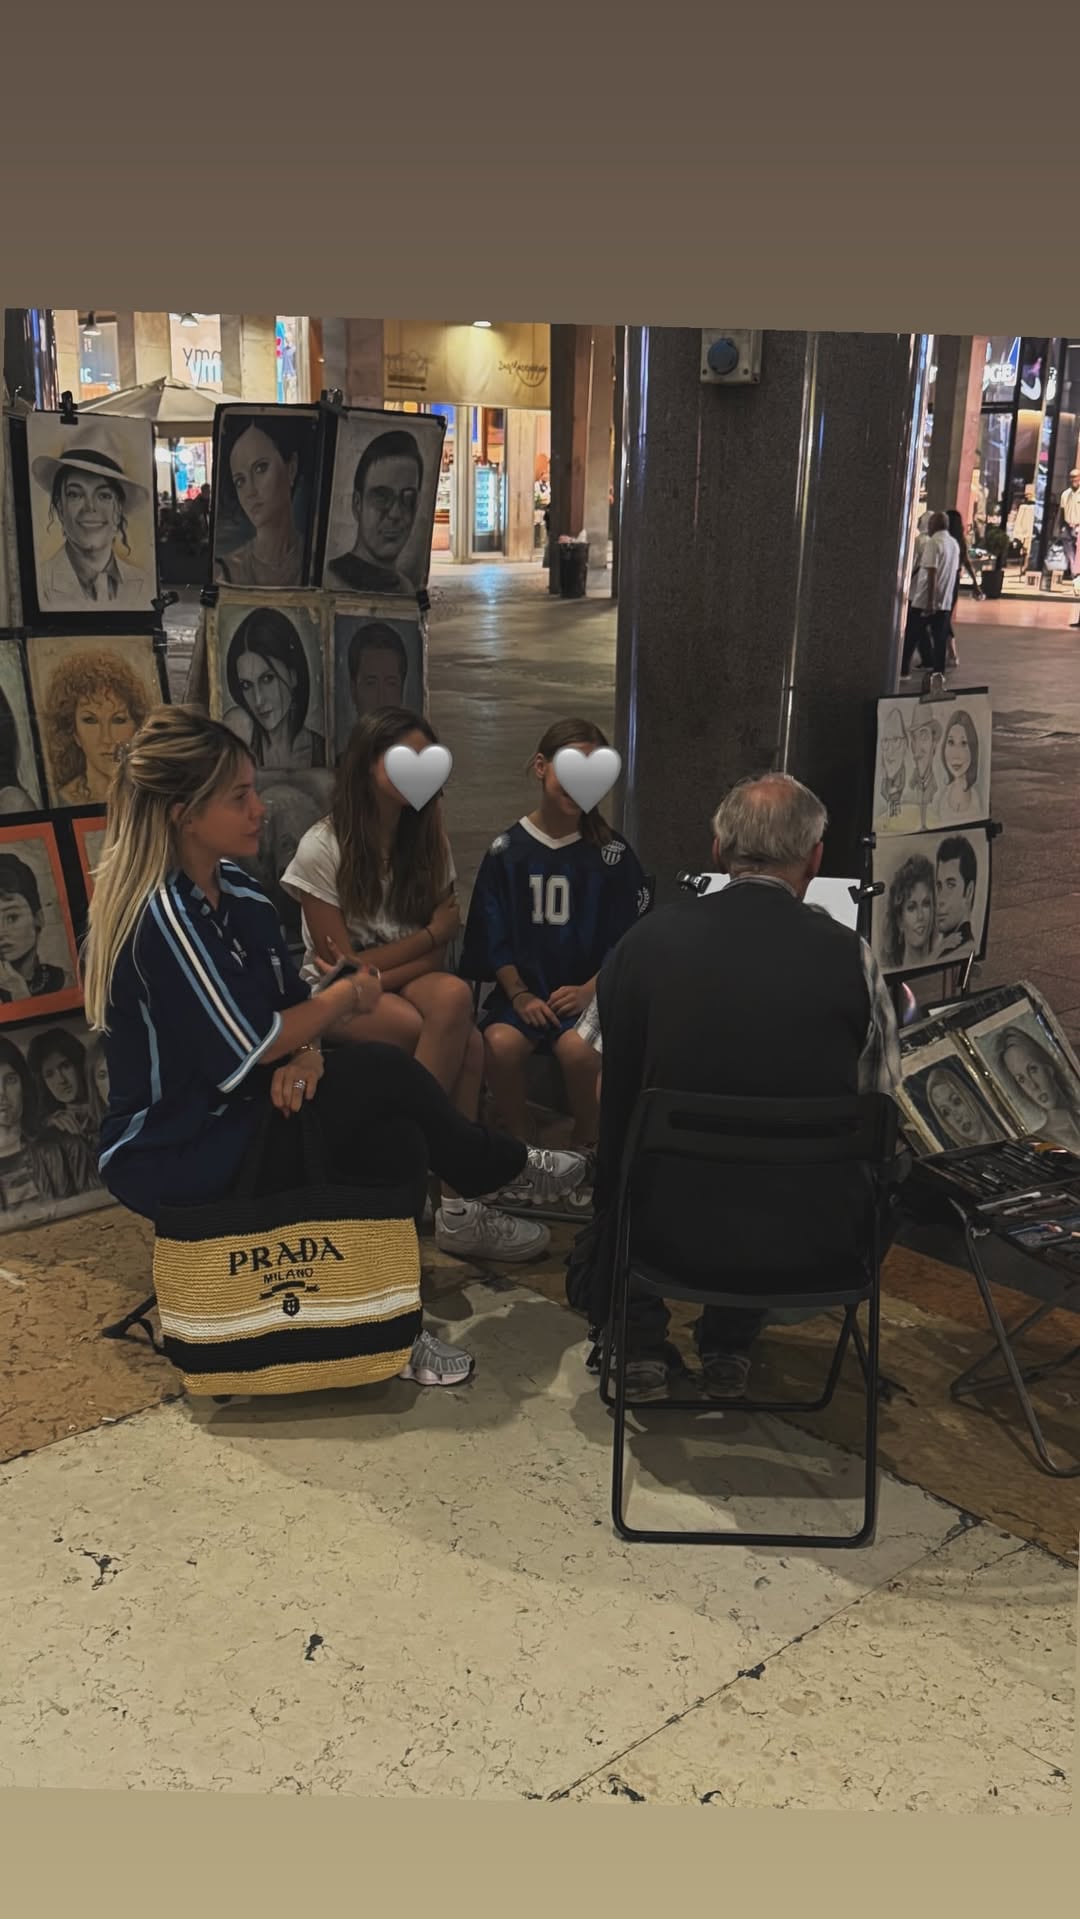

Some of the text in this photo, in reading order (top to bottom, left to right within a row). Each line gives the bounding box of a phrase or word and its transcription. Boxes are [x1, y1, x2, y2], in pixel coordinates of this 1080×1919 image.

[528, 874, 571, 926] 10
[228, 1236, 344, 1276] PRADA
[262, 1267, 314, 1285] MILANO
